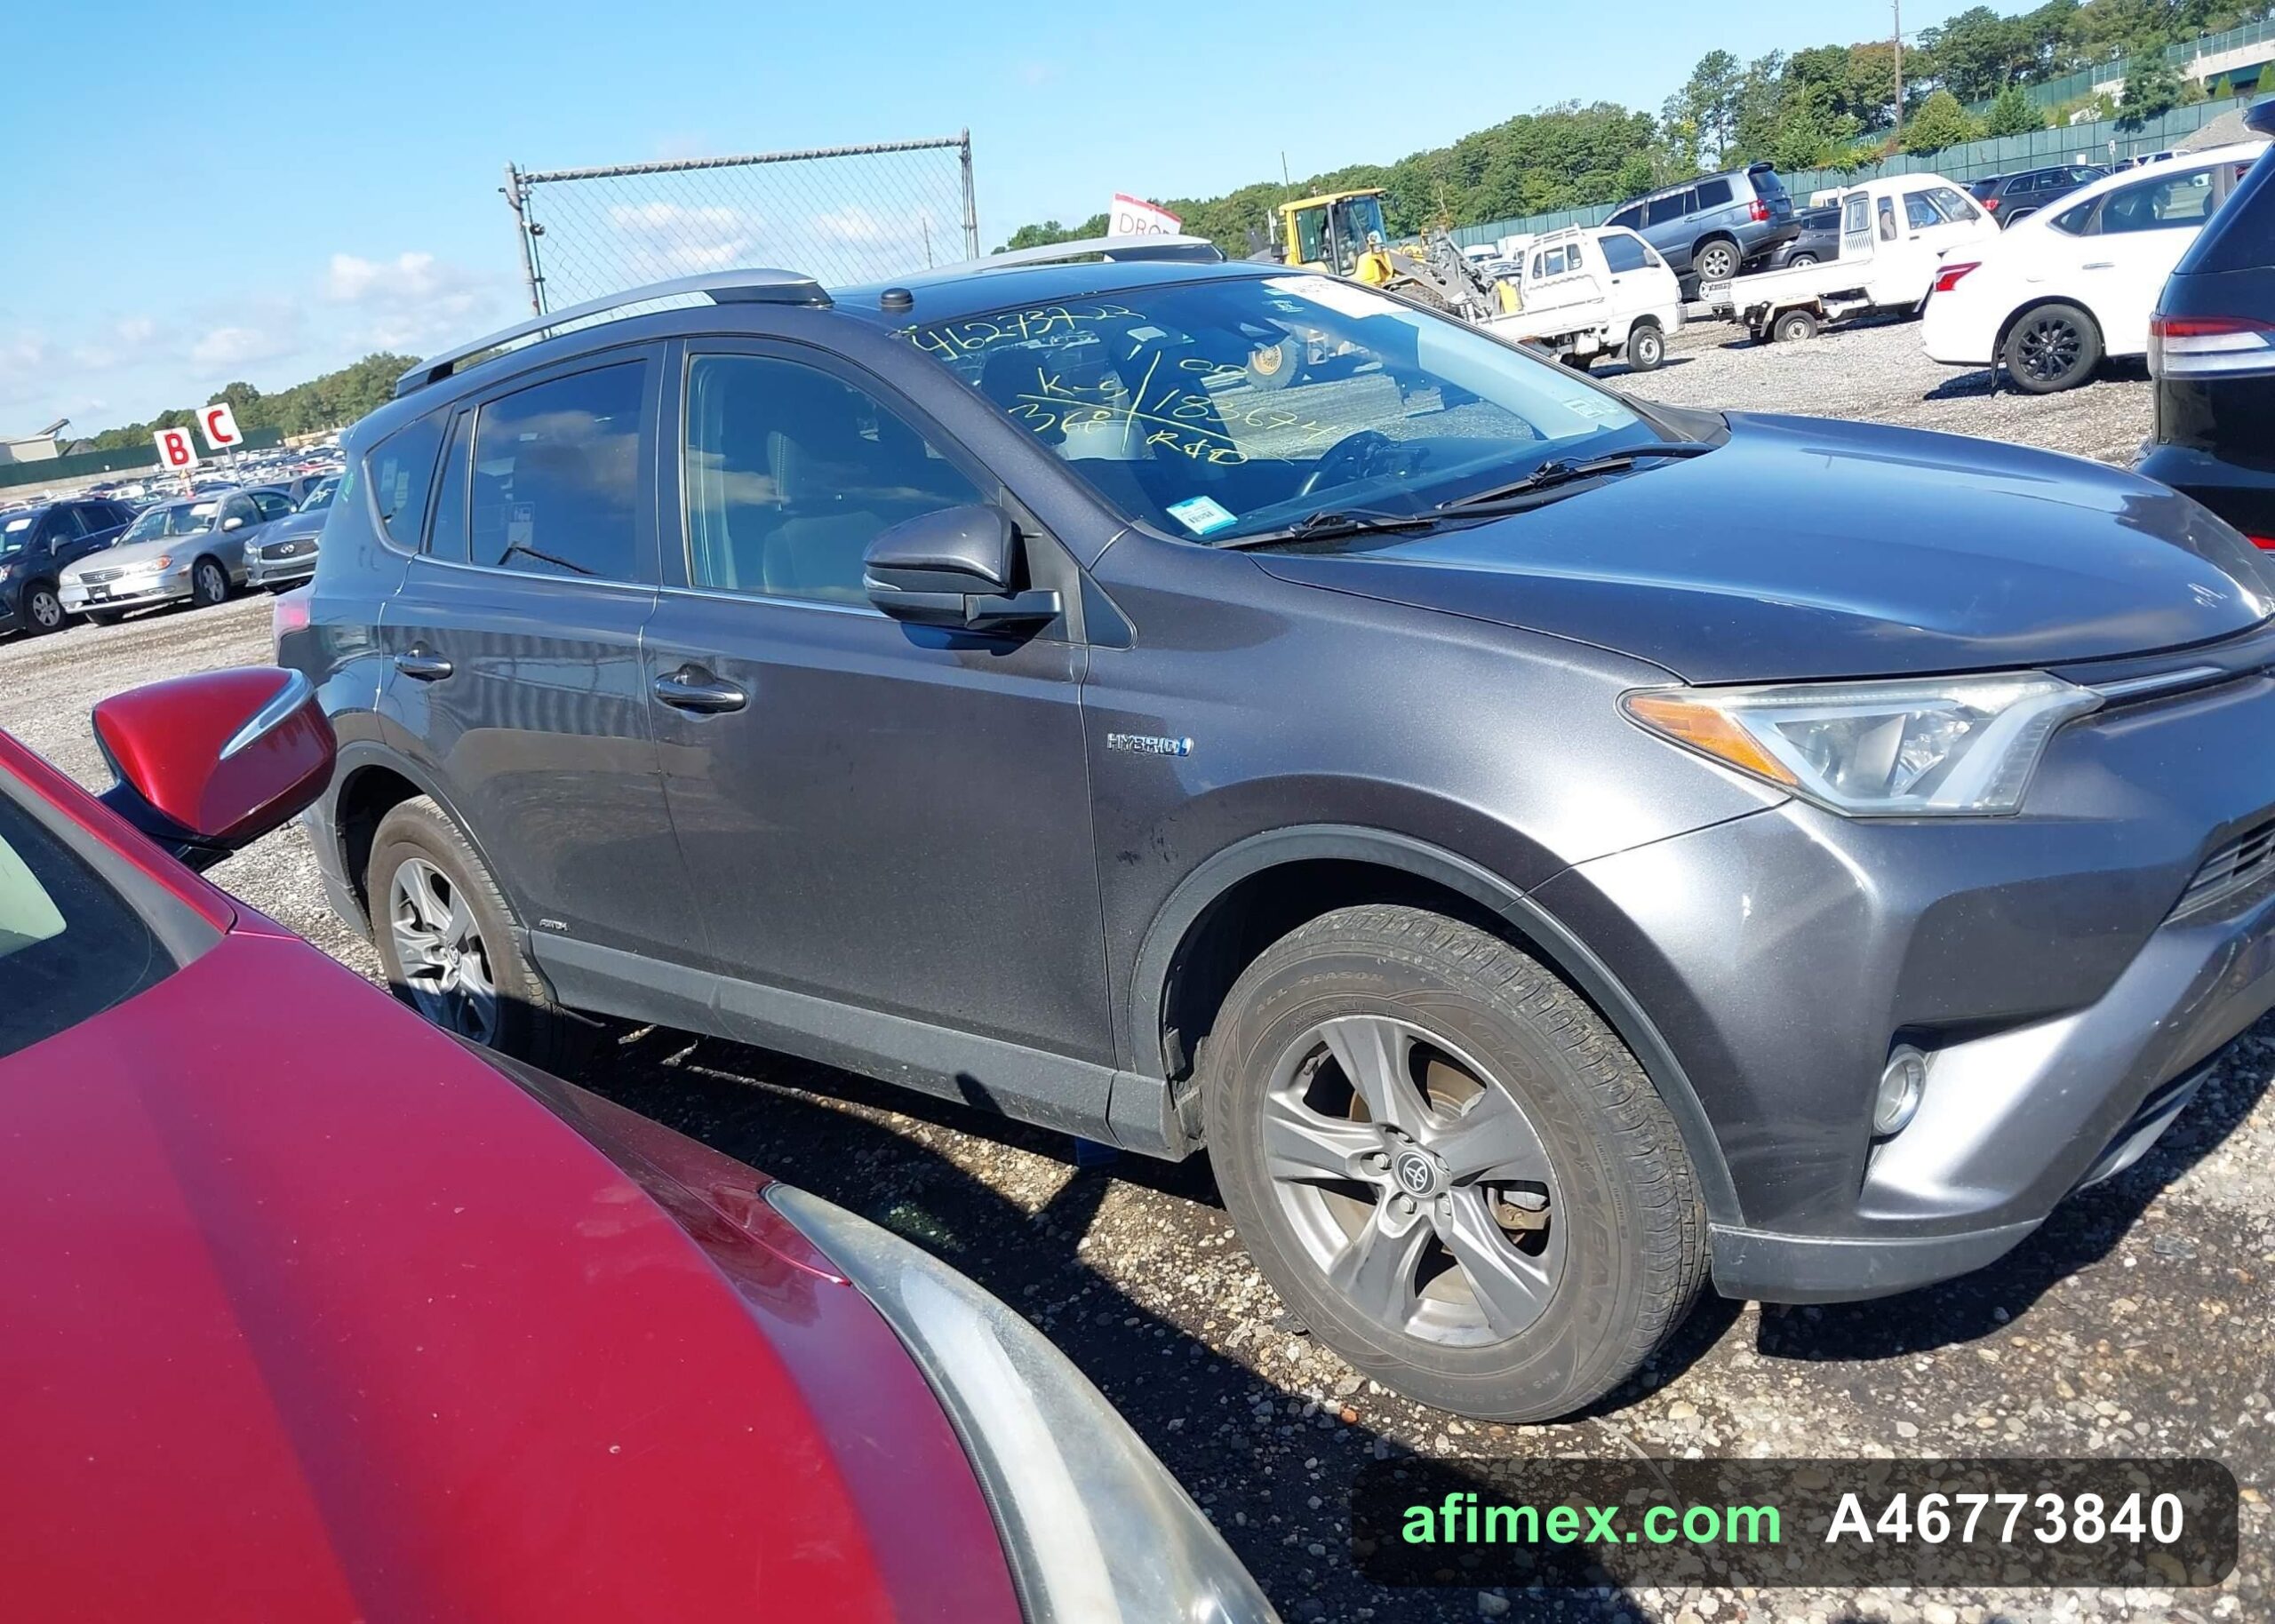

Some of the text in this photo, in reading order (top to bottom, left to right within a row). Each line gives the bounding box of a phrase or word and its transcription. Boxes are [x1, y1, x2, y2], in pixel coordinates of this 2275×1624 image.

[1119, 212, 1170, 235] DRO
[207, 410, 234, 442] C
[164, 433, 189, 466] B
[1106, 732, 1179, 756] HYBRID
